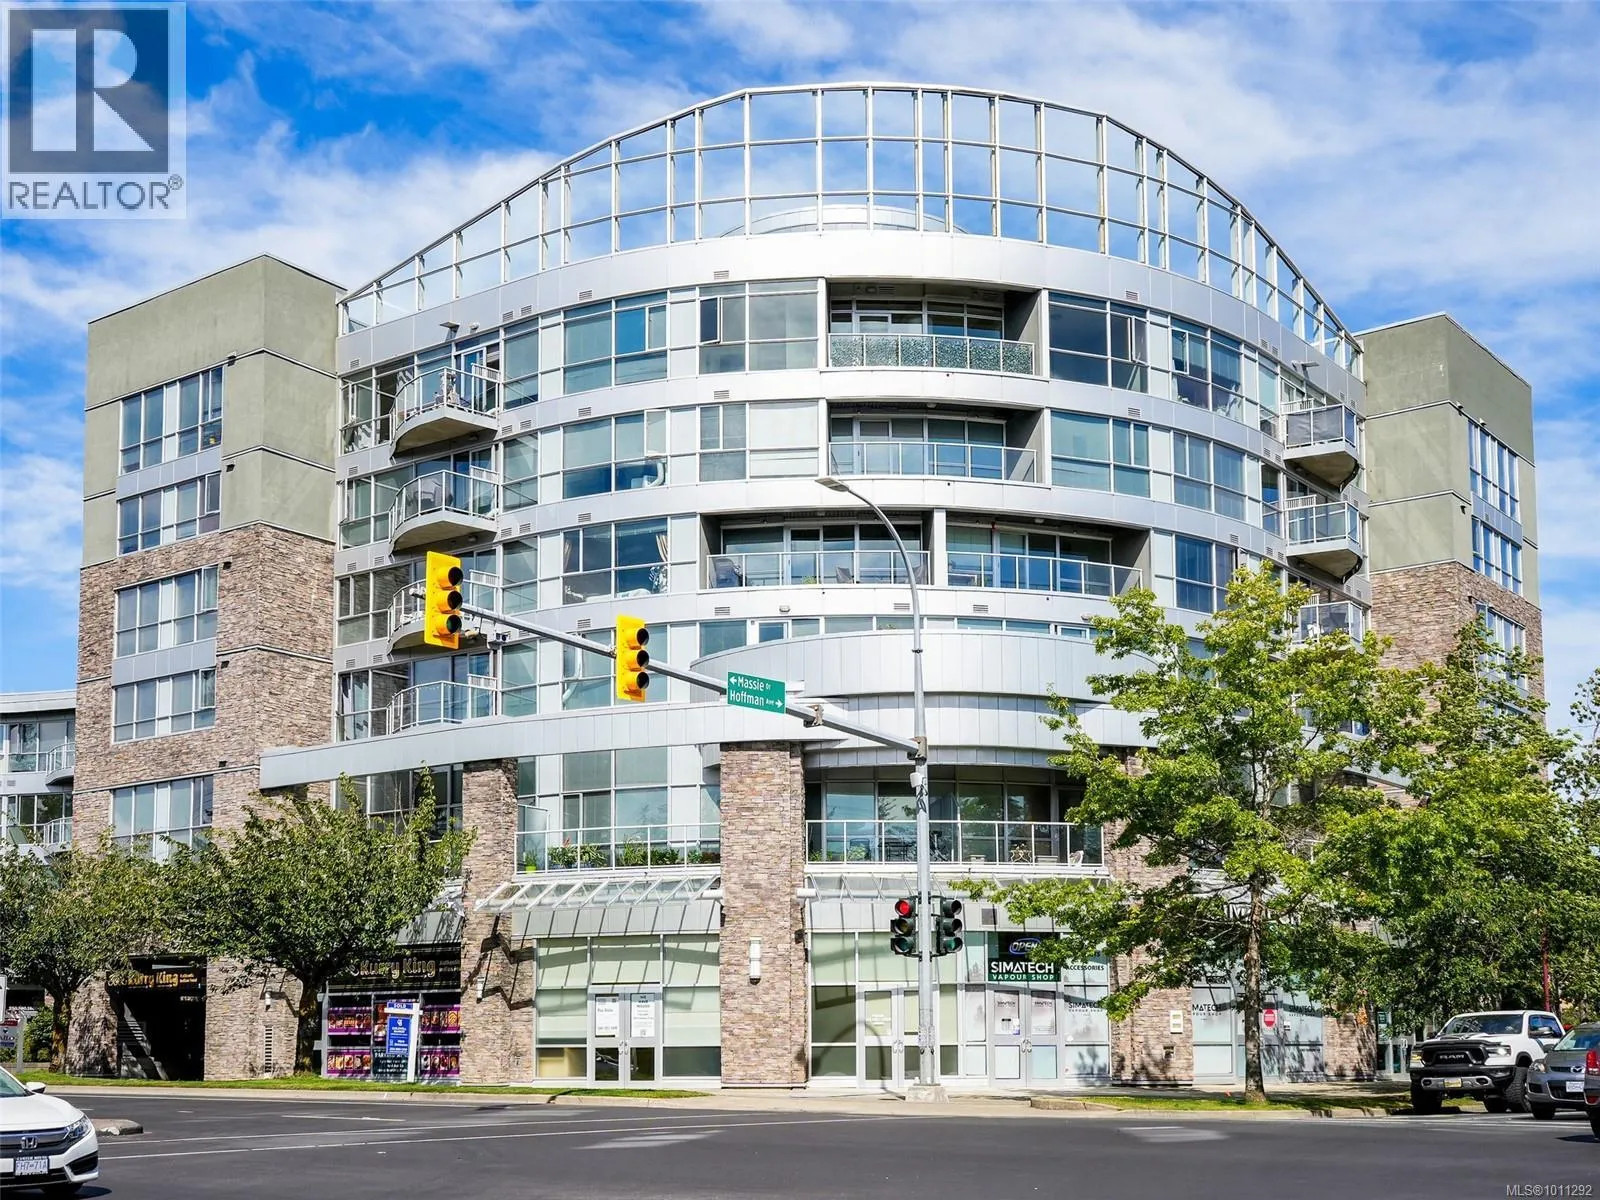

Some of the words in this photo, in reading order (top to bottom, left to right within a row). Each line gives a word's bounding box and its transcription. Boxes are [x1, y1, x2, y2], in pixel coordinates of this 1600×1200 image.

[737, 676, 765, 691] Massie
[730, 690, 765, 706] Hoffman
[1010, 941, 1038, 953] OPEN
[402, 957, 436, 977] King
[991, 961, 1055, 974] SIMATECH
[156, 971, 179, 987] King
[1069, 1001, 1103, 1009] SIMATEC
